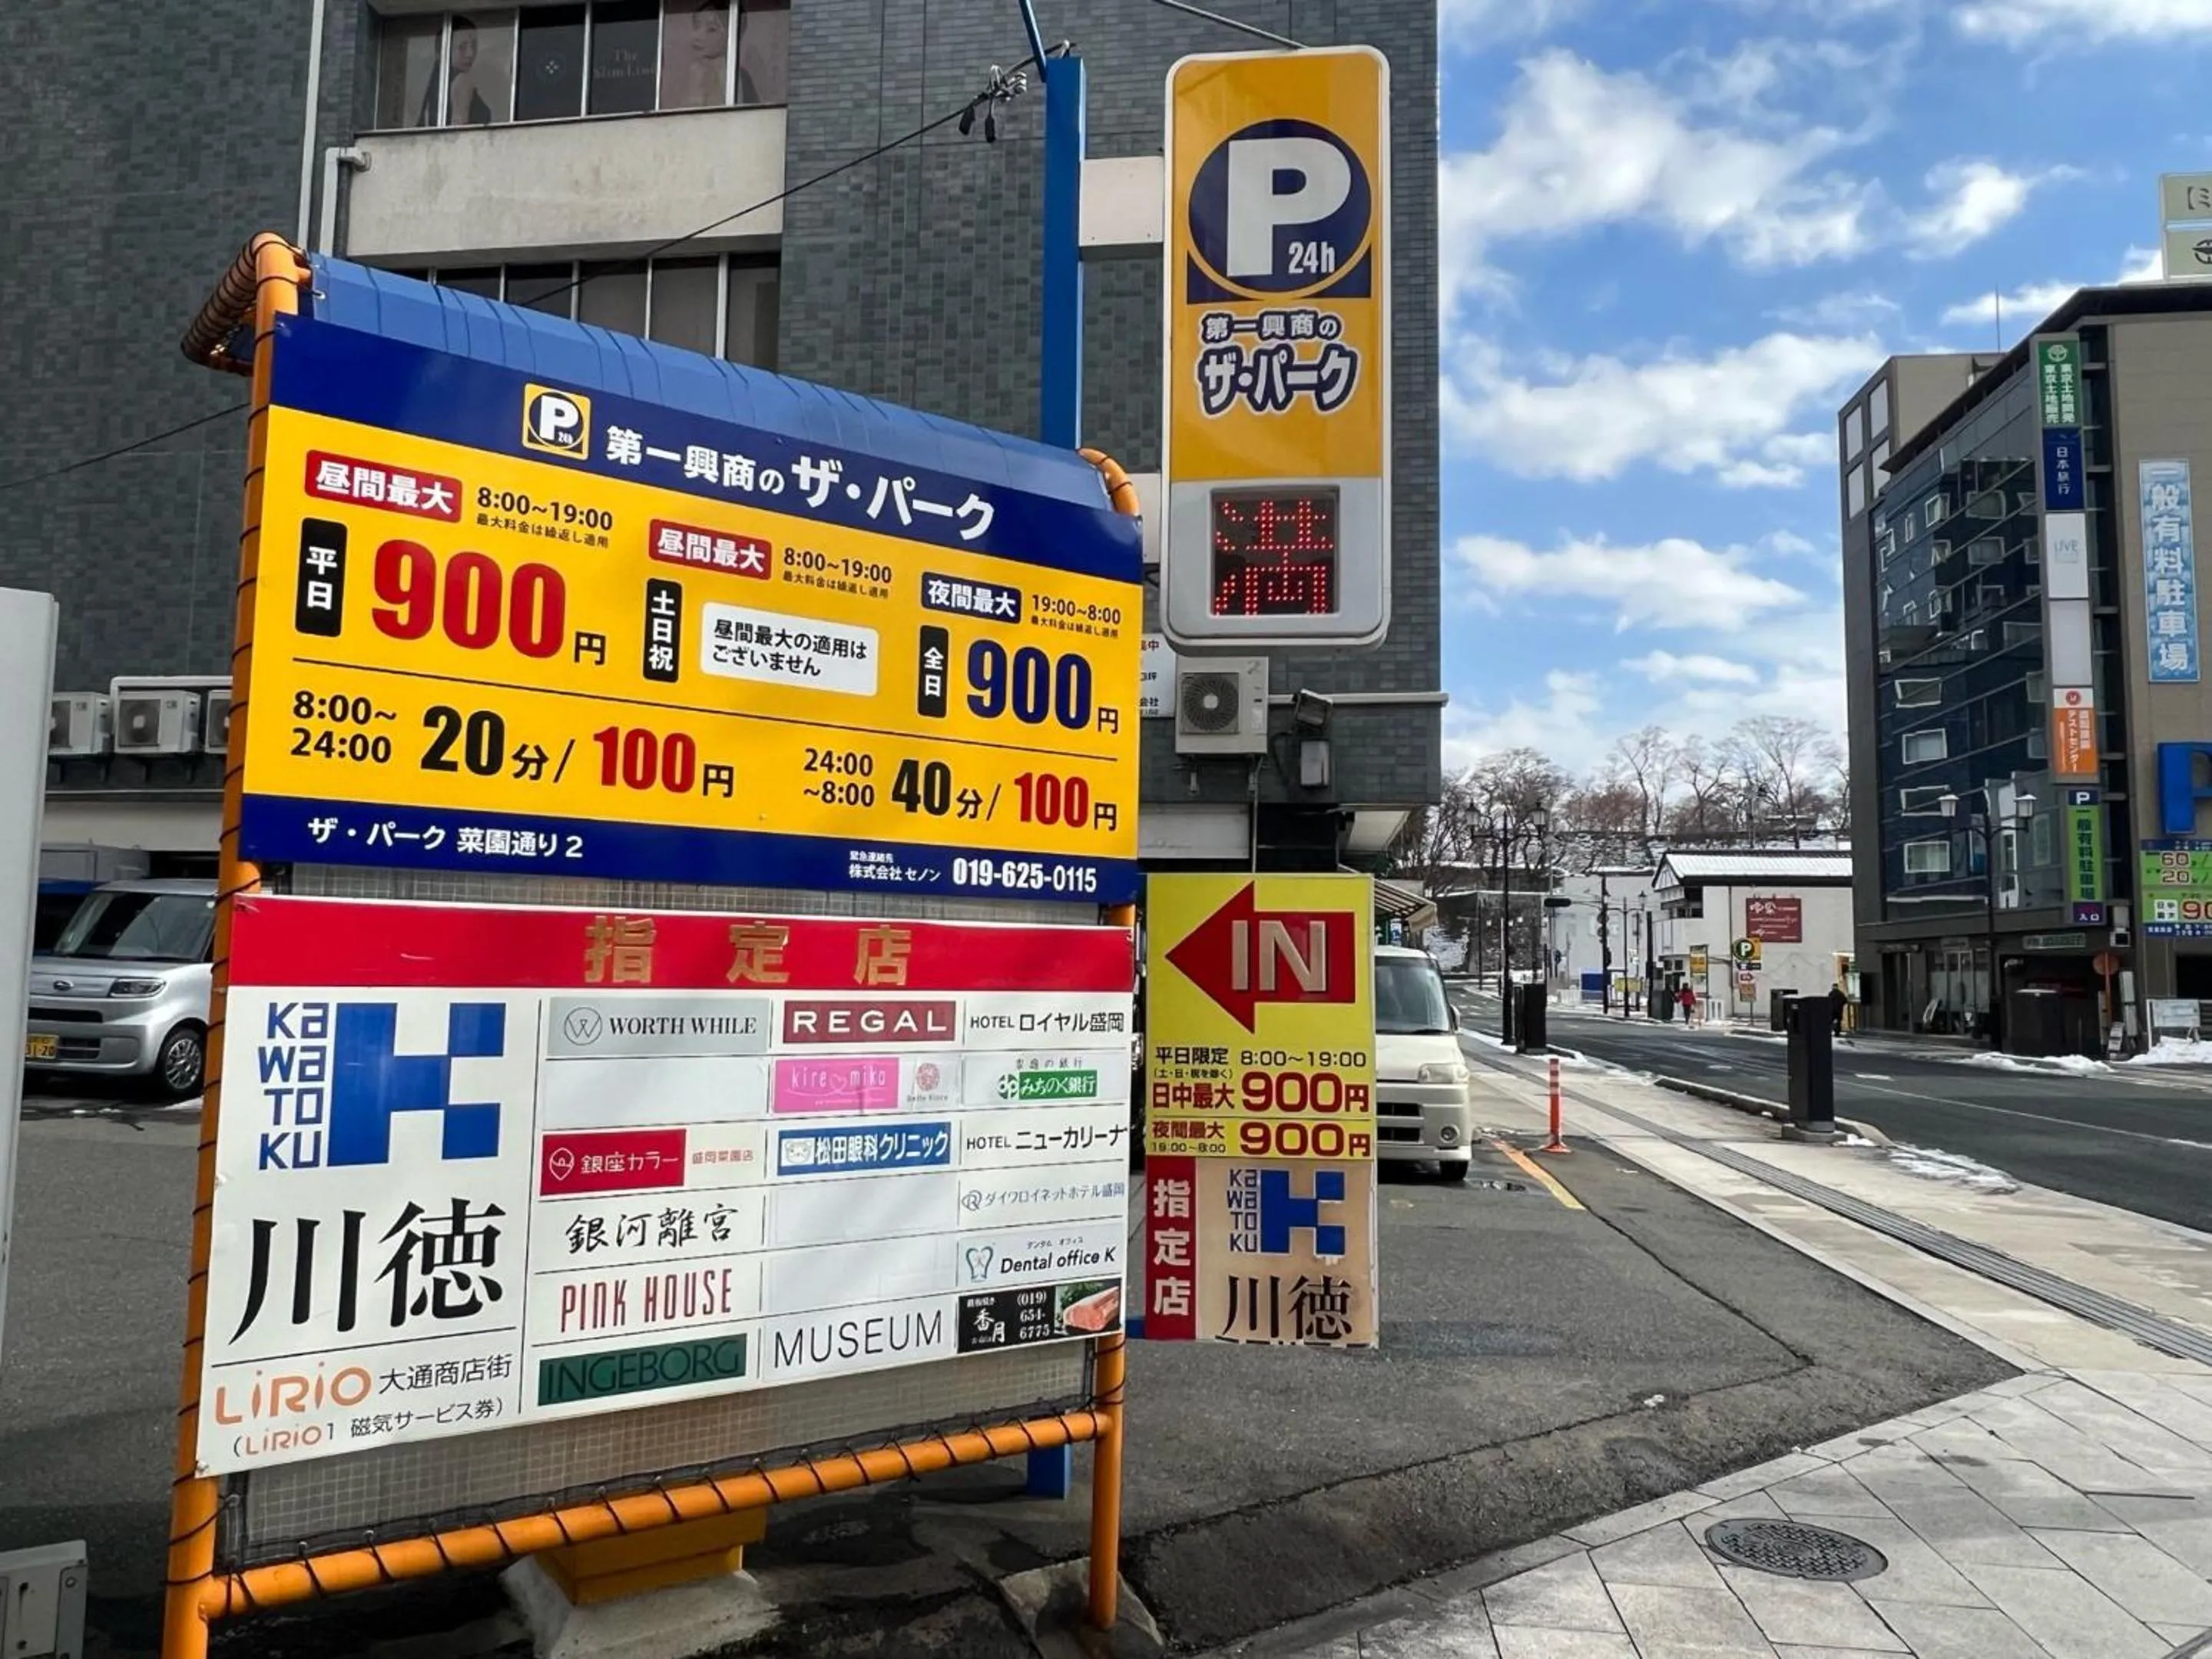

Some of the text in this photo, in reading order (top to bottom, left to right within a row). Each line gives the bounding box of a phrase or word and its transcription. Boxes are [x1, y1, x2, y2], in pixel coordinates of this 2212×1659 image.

[1227, 137, 1352, 277] P
[1288, 241, 1335, 273] 24h
[1205, 312, 1339, 340] 第一興商の
[1204, 348, 1351, 409] ザ・パーク
[540, 395, 578, 440] P
[316, 460, 453, 515] 昼間最大
[657, 528, 765, 572] 昼間最大
[306, 546, 336, 610] 平日
[2151, 469, 2188, 671] 一般有料駐車場
[928, 579, 1017, 617] 夜間最大
[649, 591, 867, 672] 土日祝 昼間最大の適用は
[712, 643, 822, 677] ございません
[923, 647, 944, 697] 全日
[290, 727, 392, 763] 24:00
[803, 748, 873, 777] 24:00
[2076, 791, 2090, 804] P
[309, 817, 446, 850] ザ・パーク
[952, 857, 1097, 892] 019-625-0115
[1232, 920, 1326, 992] IN
[1740, 942, 1751, 956] P
[610, 1017, 757, 1035] WORTH WHILE
[793, 1010, 946, 1033] REGAL
[971, 1012, 1124, 1031] HOTEL ロイヤル盛岡
[1156, 1047, 1228, 1065] 平日限定
[1022, 1075, 1094, 1095] みちのく銀行
[1153, 1082, 1235, 1109] 日中最大
[967, 1124, 1128, 1150] HOTEL ニューカリーナ
[1153, 1121, 1225, 1139] 夜間最大
[581, 1151, 679, 1174] 銀座カラー
[816, 1131, 949, 1164] 松田眼科クリニック
[985, 1183, 1124, 1207] ダイワロイネットホテル盛岡
[565, 1203, 739, 1253] 銀河離宮
[1000, 1247, 1116, 1273] Dental office K
[1154, 1179, 1190, 1316] 指定店
[229, 1197, 506, 1346] 川徳
[561, 1269, 732, 1332] PINK HOUSE
[1018, 1290, 1047, 1306] (019)
[1223, 1275, 1352, 1339] 川徳
[774, 1310, 941, 1369] MUSEUM
[1020, 1324, 1049, 1339] 6775
[379, 1354, 512, 1394] 大通商店街
[548, 1340, 740, 1399] INGEBORG
